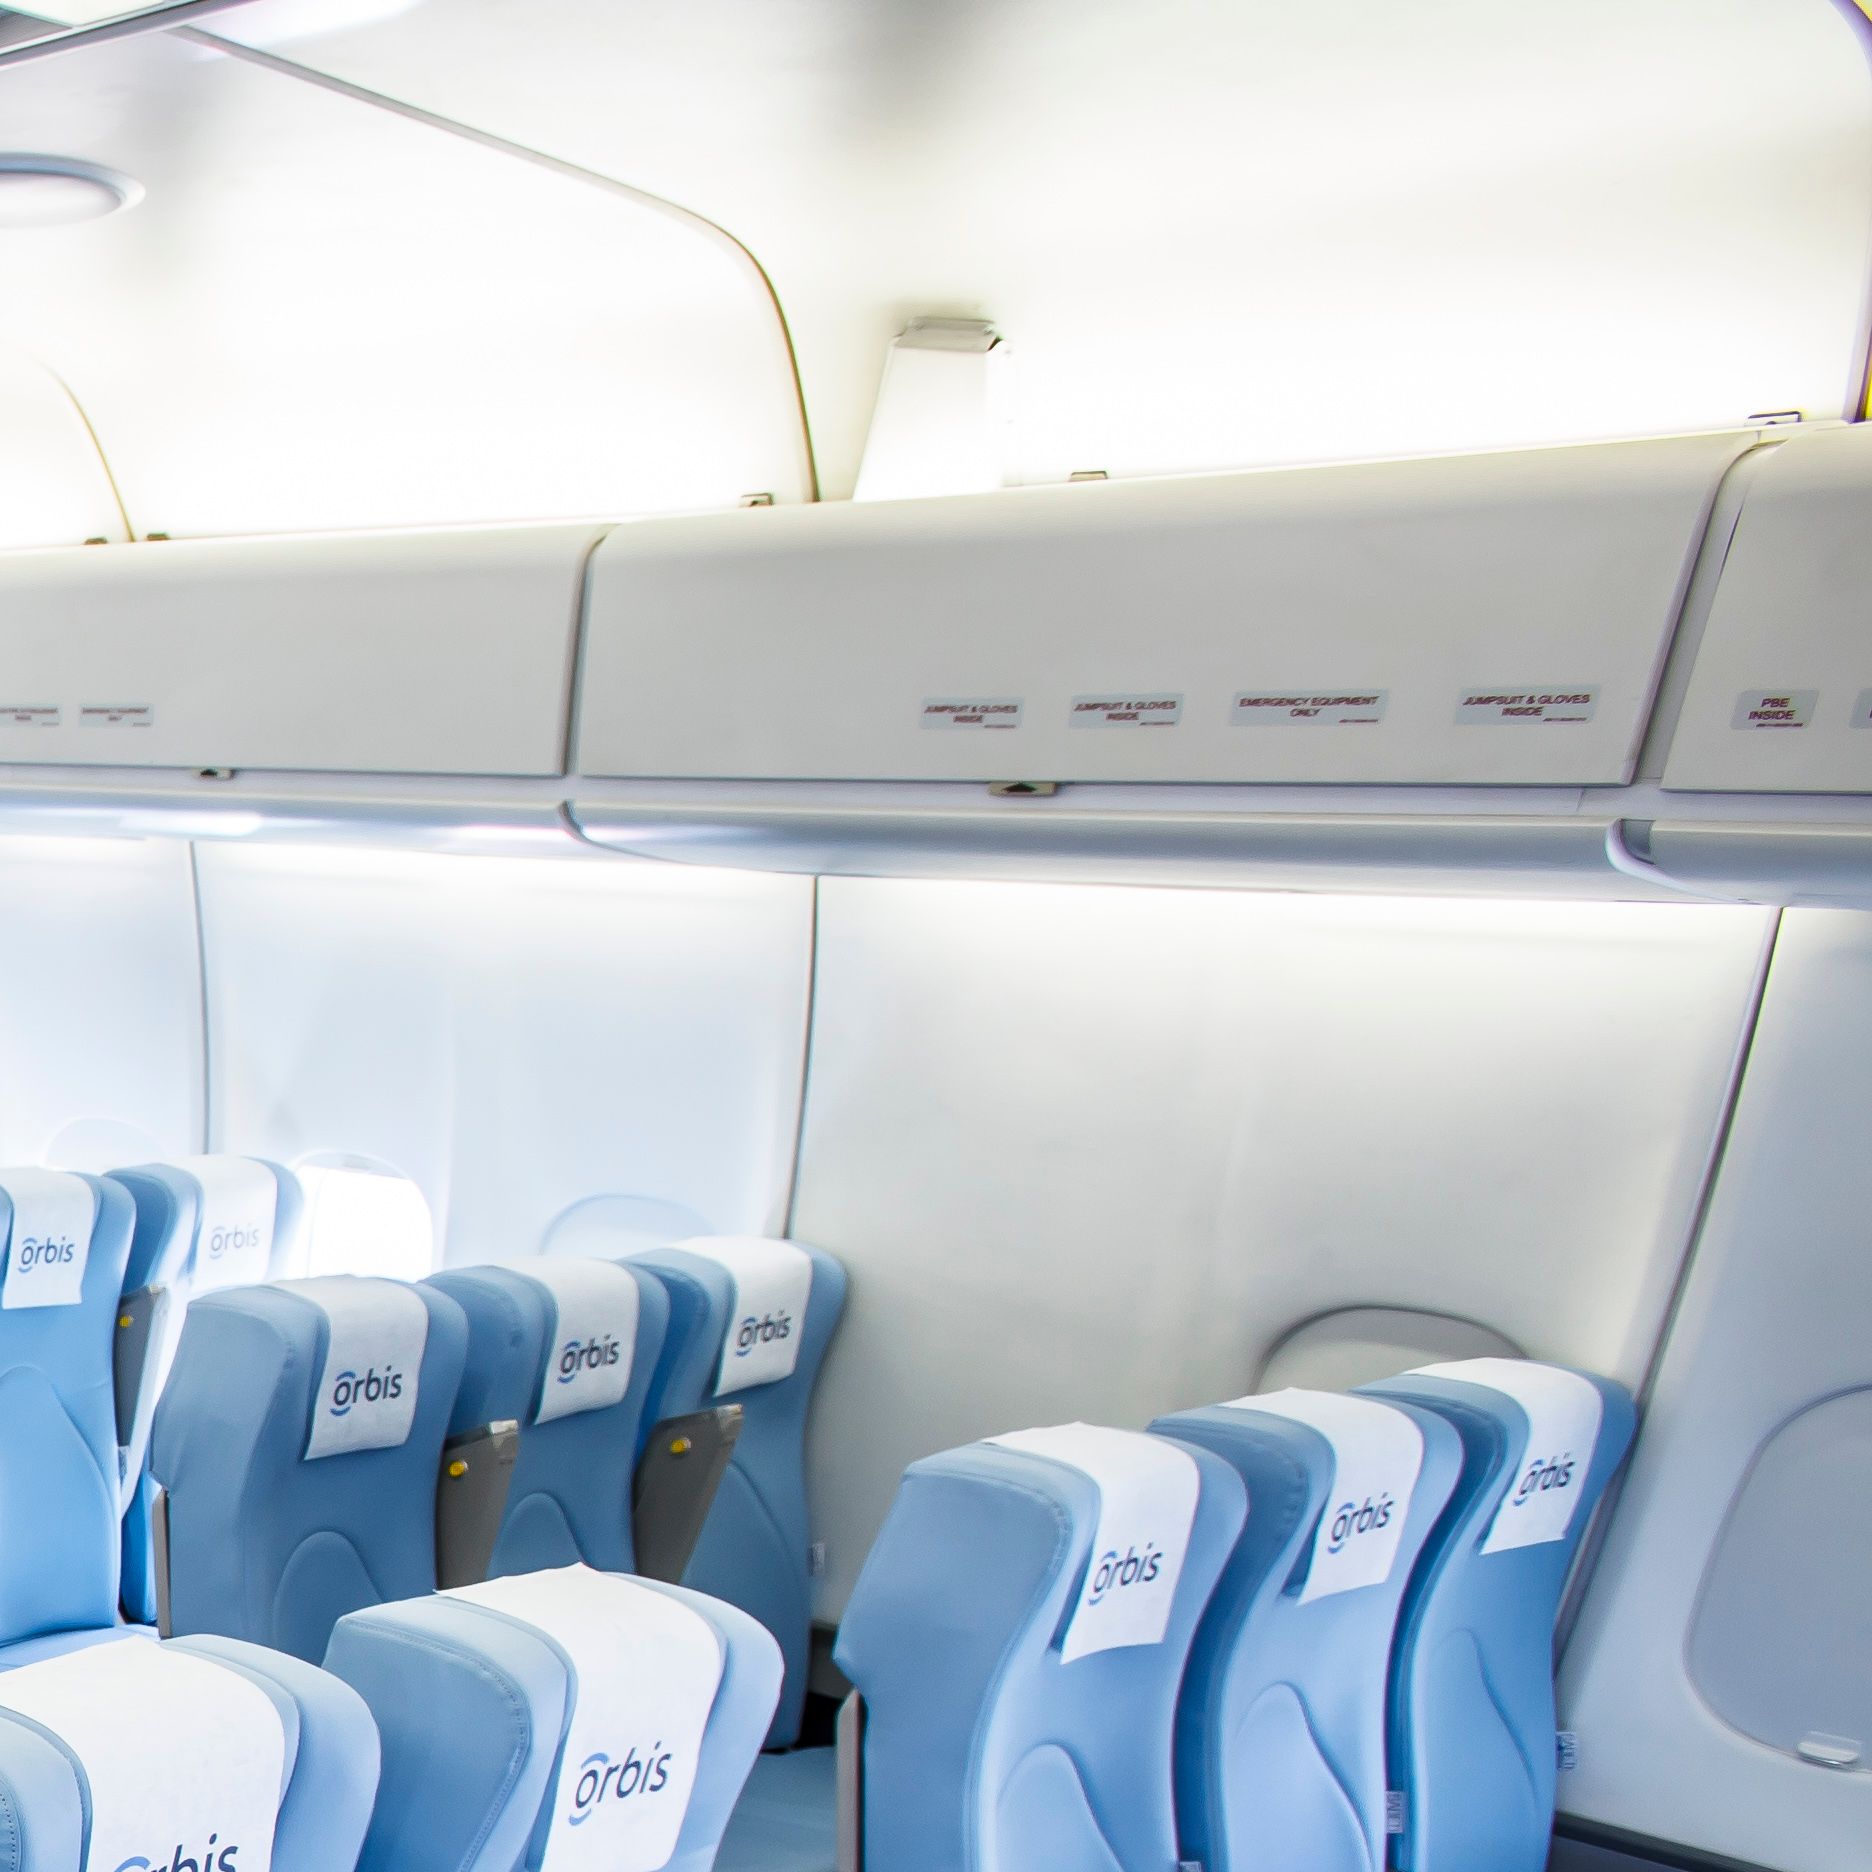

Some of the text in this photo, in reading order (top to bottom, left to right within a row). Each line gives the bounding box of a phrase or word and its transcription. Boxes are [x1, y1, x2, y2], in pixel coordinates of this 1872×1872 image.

[1134, 700, 1177, 710] GLOVES
[1239, 696, 1380, 707] EMERGENCY EQUIPMENT
[1289, 708, 1321, 717] ONLY
[1463, 695, 1592, 706] JUMPSUIT & GLOVES
[1761, 698, 1790, 707] PBE
[1748, 710, 1796, 720] INSIDE
[21, 1238, 74, 1265] orbis
[737, 1311, 791, 1347] orbis
[560, 1335, 619, 1374] orbis
[333, 1365, 401, 1407] orbis
[1331, 1494, 1393, 1541] orbis
[1092, 1542, 1161, 1594] orbis
[573, 1740, 671, 1810] orbis
